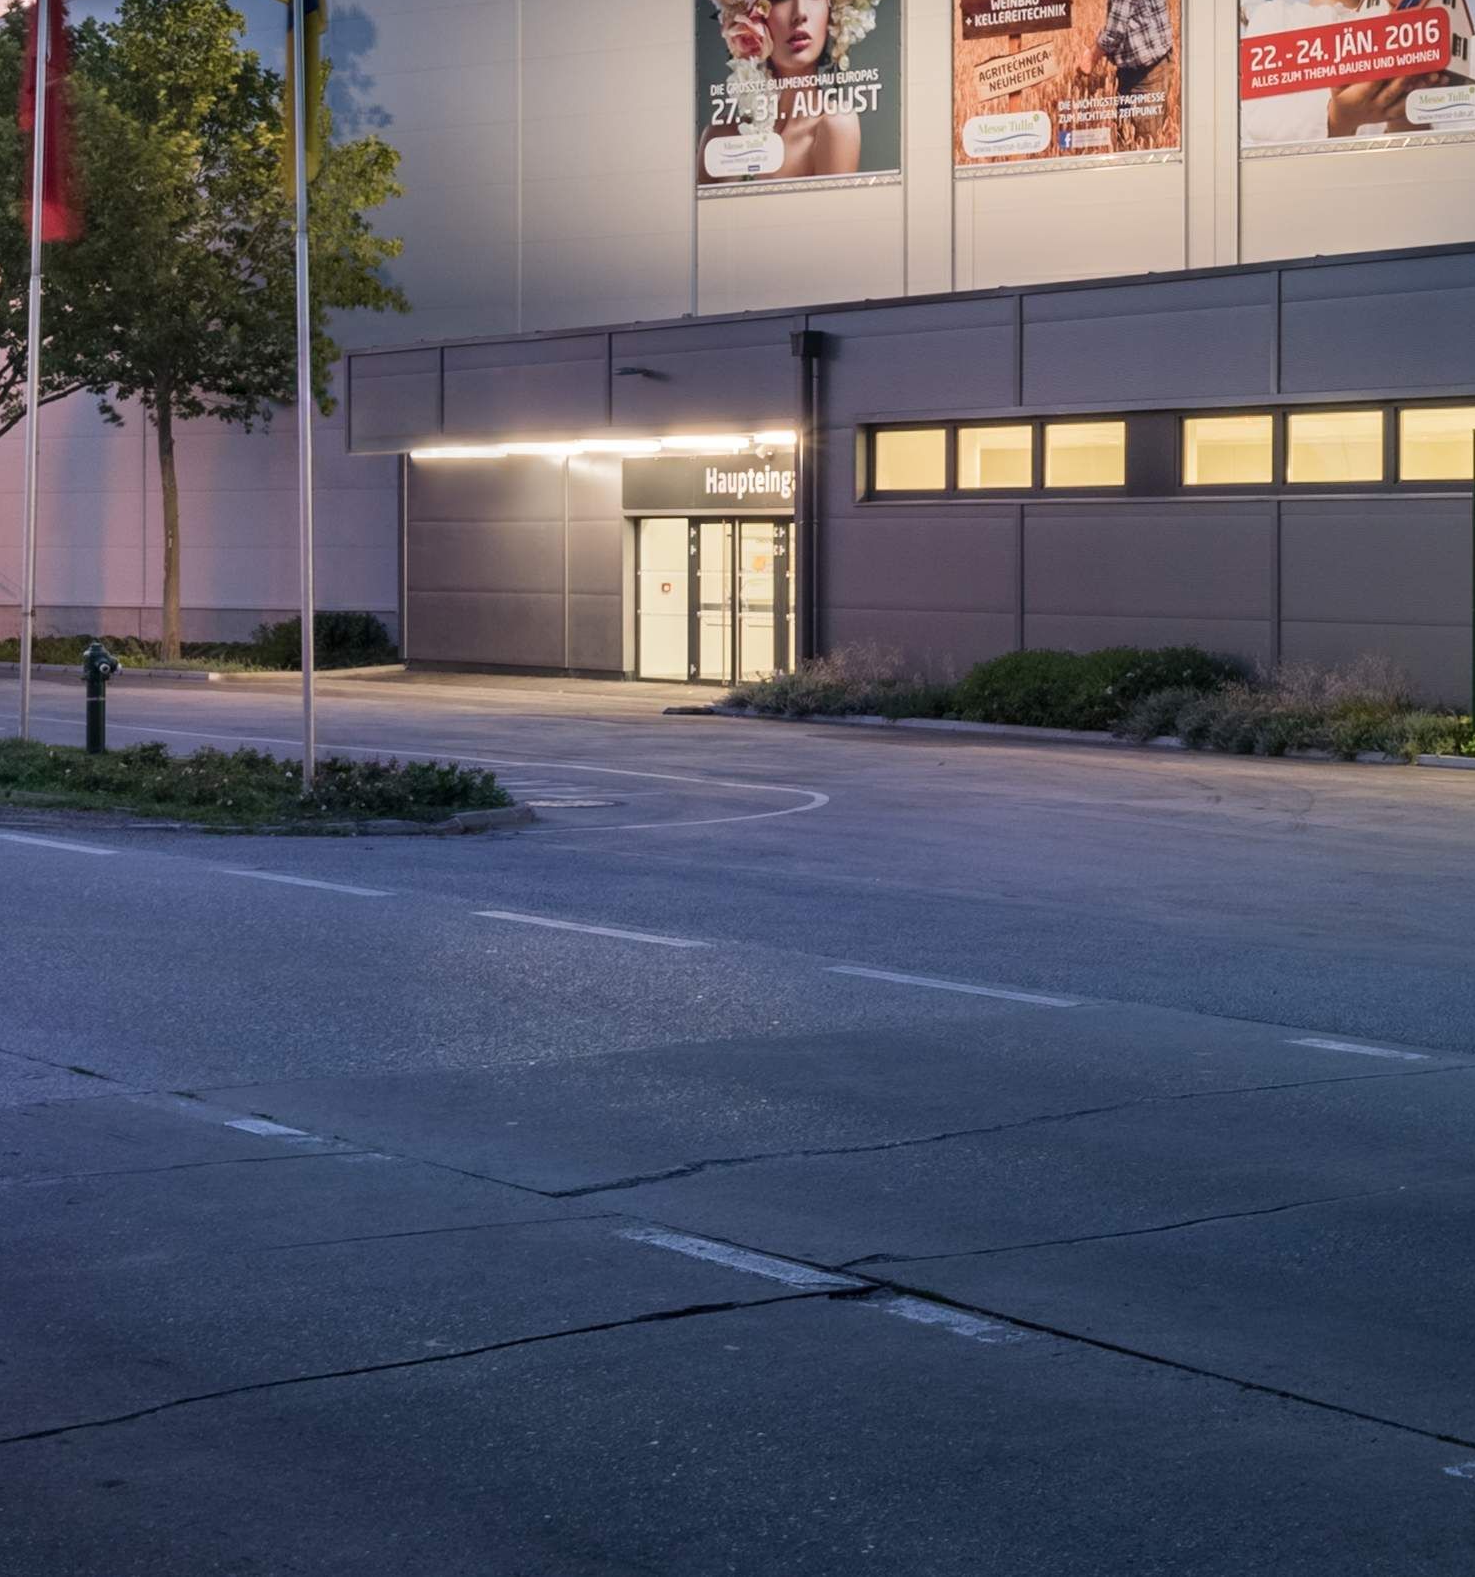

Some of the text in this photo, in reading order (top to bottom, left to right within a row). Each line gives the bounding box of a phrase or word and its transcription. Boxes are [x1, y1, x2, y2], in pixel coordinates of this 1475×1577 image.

[974, 3, 1066, 27] KELLEREITECHNIK
[1333, 27, 1378, 63] JÄN.
[1384, 19, 1440, 51] 2016
[710, 83, 725, 97] DIE
[836, 68, 879, 84] EUROPAS
[989, 65, 1045, 92] NEUHEITEN
[1251, 49, 1440, 89] ALLES ZUM THEMA BAUEN UND WOHNEN
[792, 84, 882, 120] AUGUST
